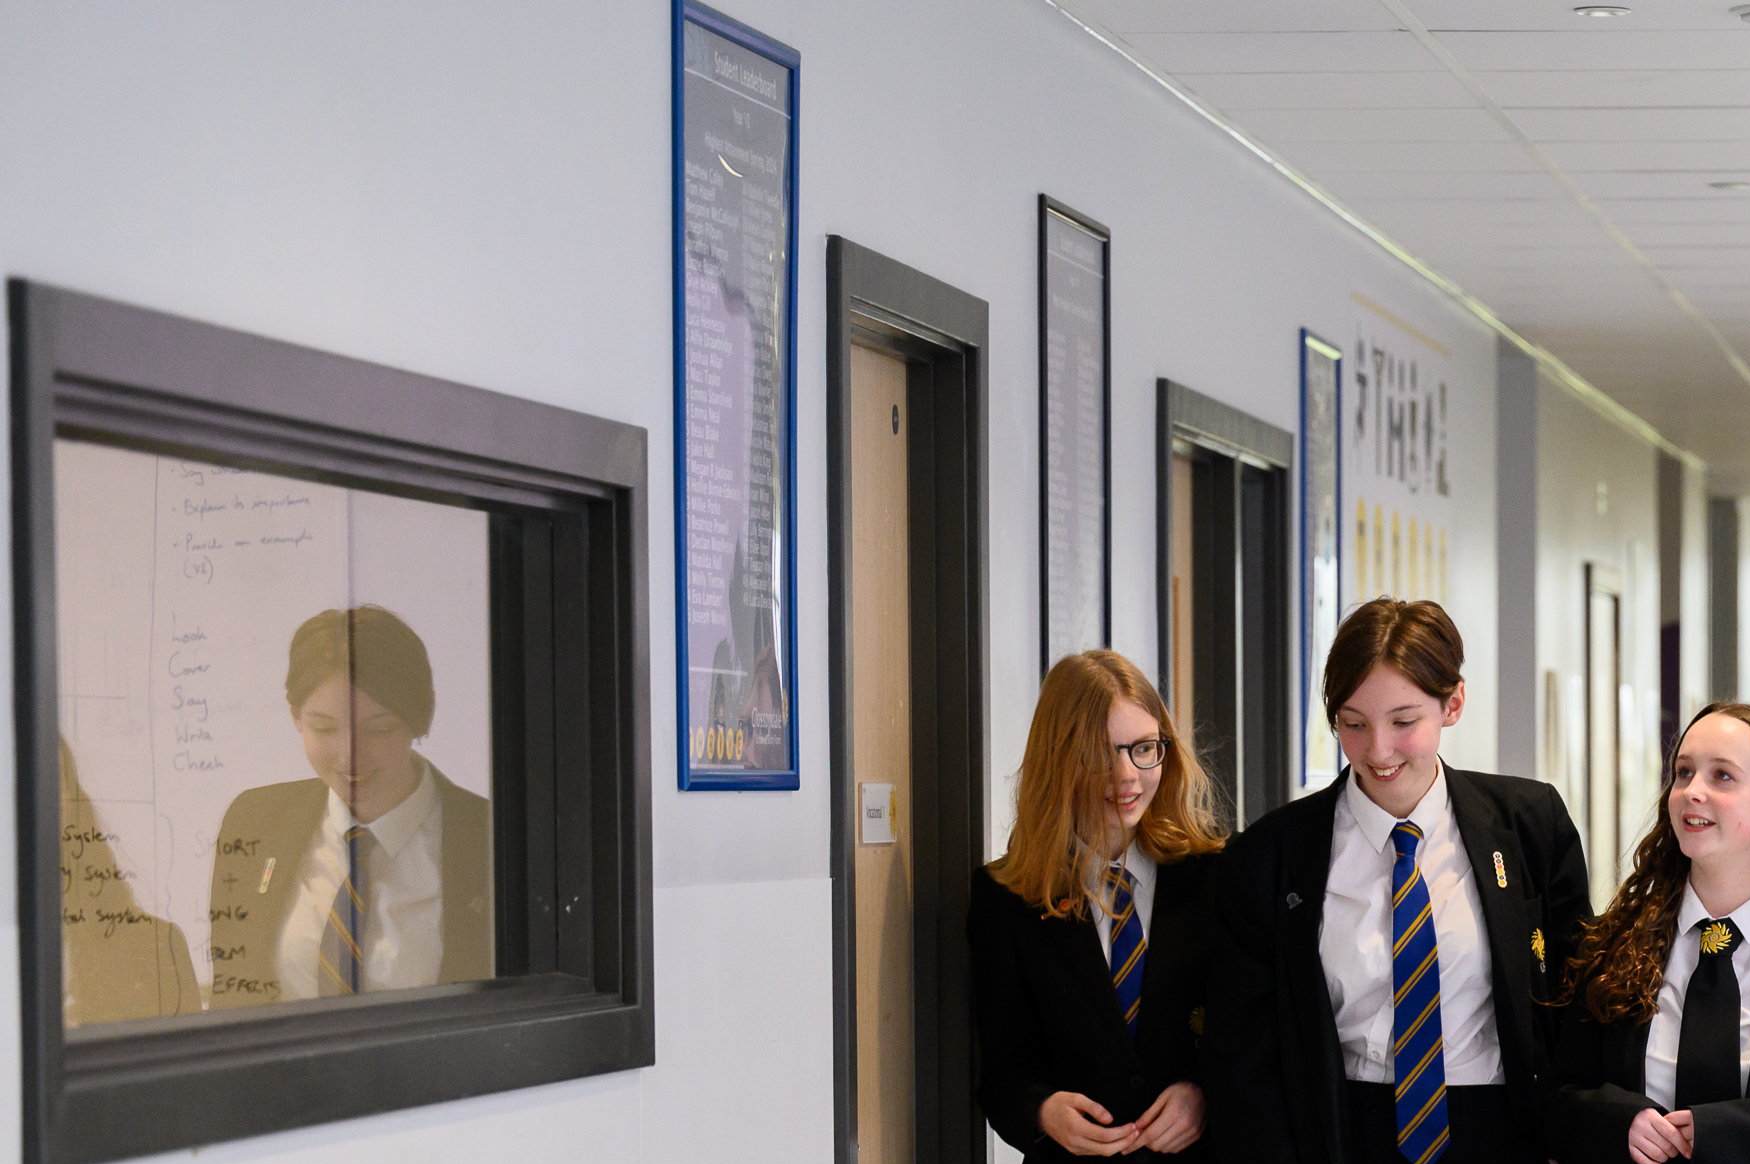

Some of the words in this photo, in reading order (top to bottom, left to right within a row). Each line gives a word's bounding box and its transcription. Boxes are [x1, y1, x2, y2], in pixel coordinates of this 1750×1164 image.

[714, 51, 739, 83] Student
[740, 64, 777, 101] Leaderboard
[704, 369, 721, 388] Taylor
[690, 384, 708, 402] Emma
[690, 403, 708, 421] Emma
[714, 463, 733, 481] Jackson
[172, 612, 207, 642] Look
[168, 651, 210, 677] Cover
[171, 685, 208, 723] Say
[175, 723, 214, 745] Write
[173, 750, 224, 772] Check
[195, 831, 261, 858] SHORT
[195, 899, 250, 923] LONG
